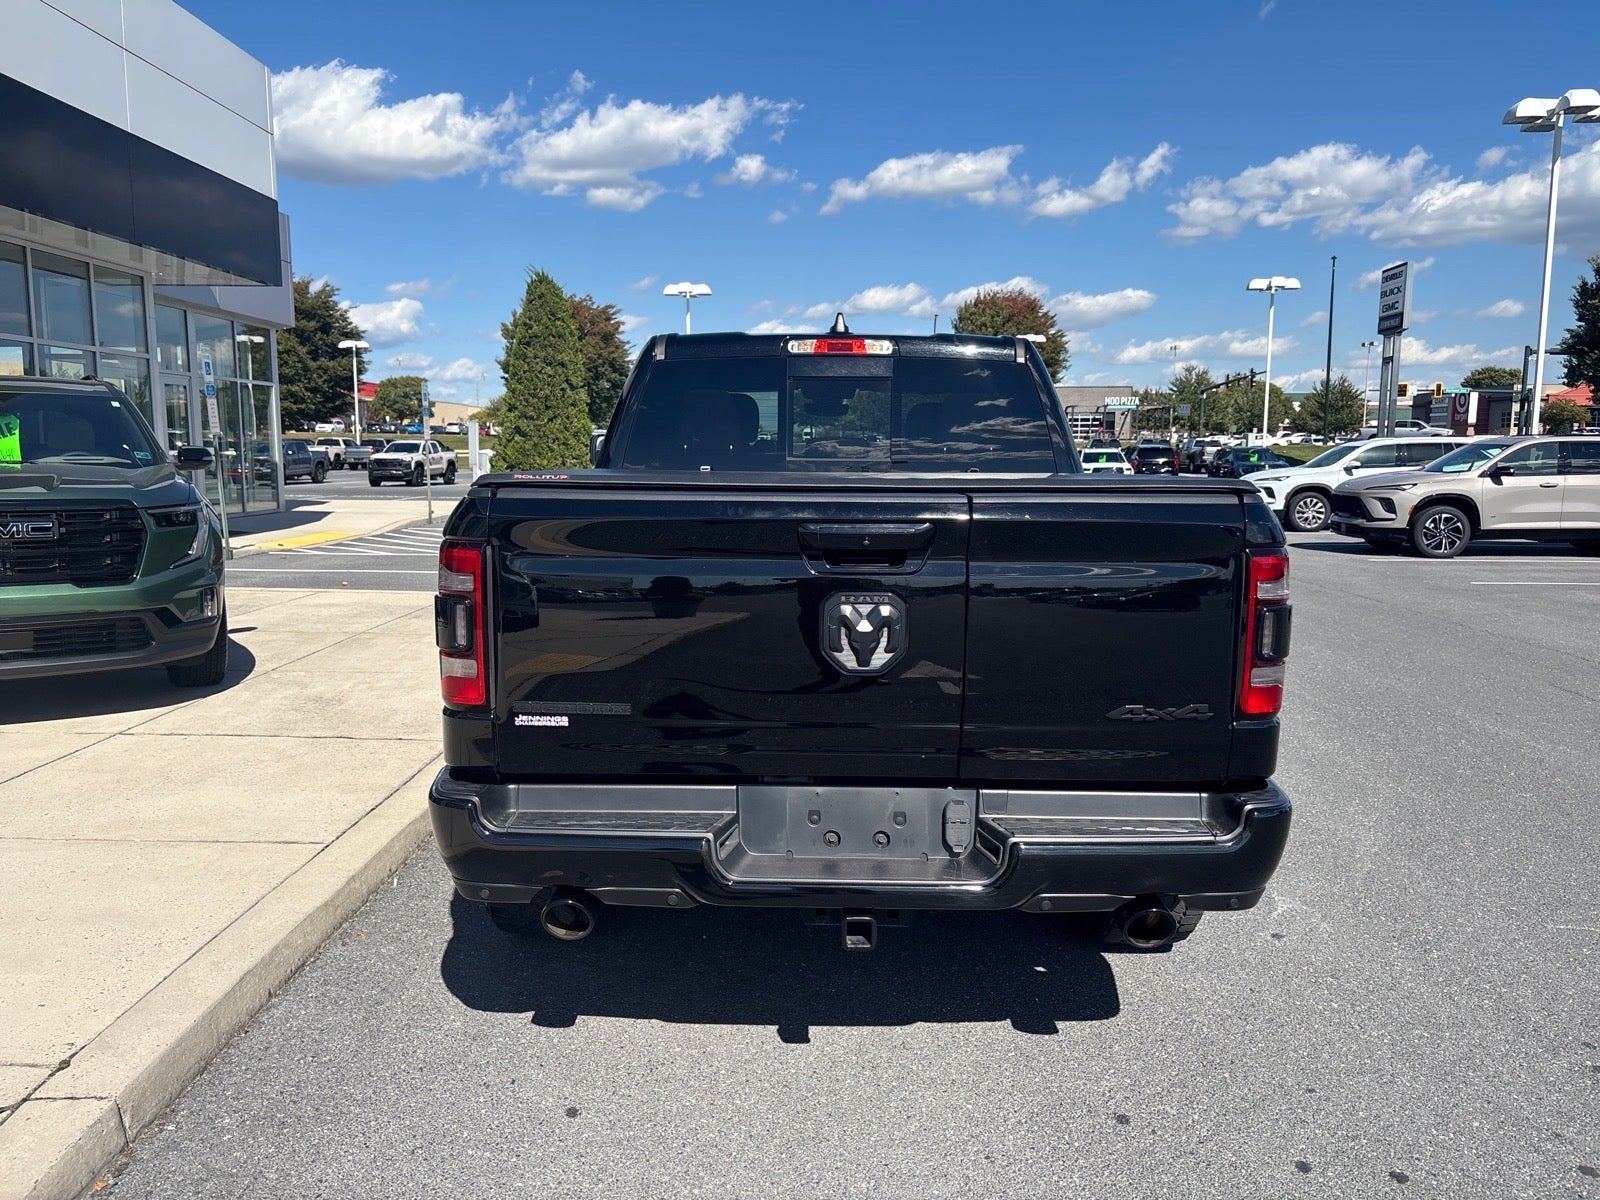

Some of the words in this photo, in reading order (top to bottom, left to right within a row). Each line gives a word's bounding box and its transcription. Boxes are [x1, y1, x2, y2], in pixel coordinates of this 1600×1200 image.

[1380, 285, 1402, 299] BUICK
[1382, 301, 1399, 313] GMC
[1121, 396, 1140, 405] PIZZA
[0, 421, 16, 440] LE
[840, 595, 889, 603] RAM
[514, 714, 569, 722] JENNINGS
